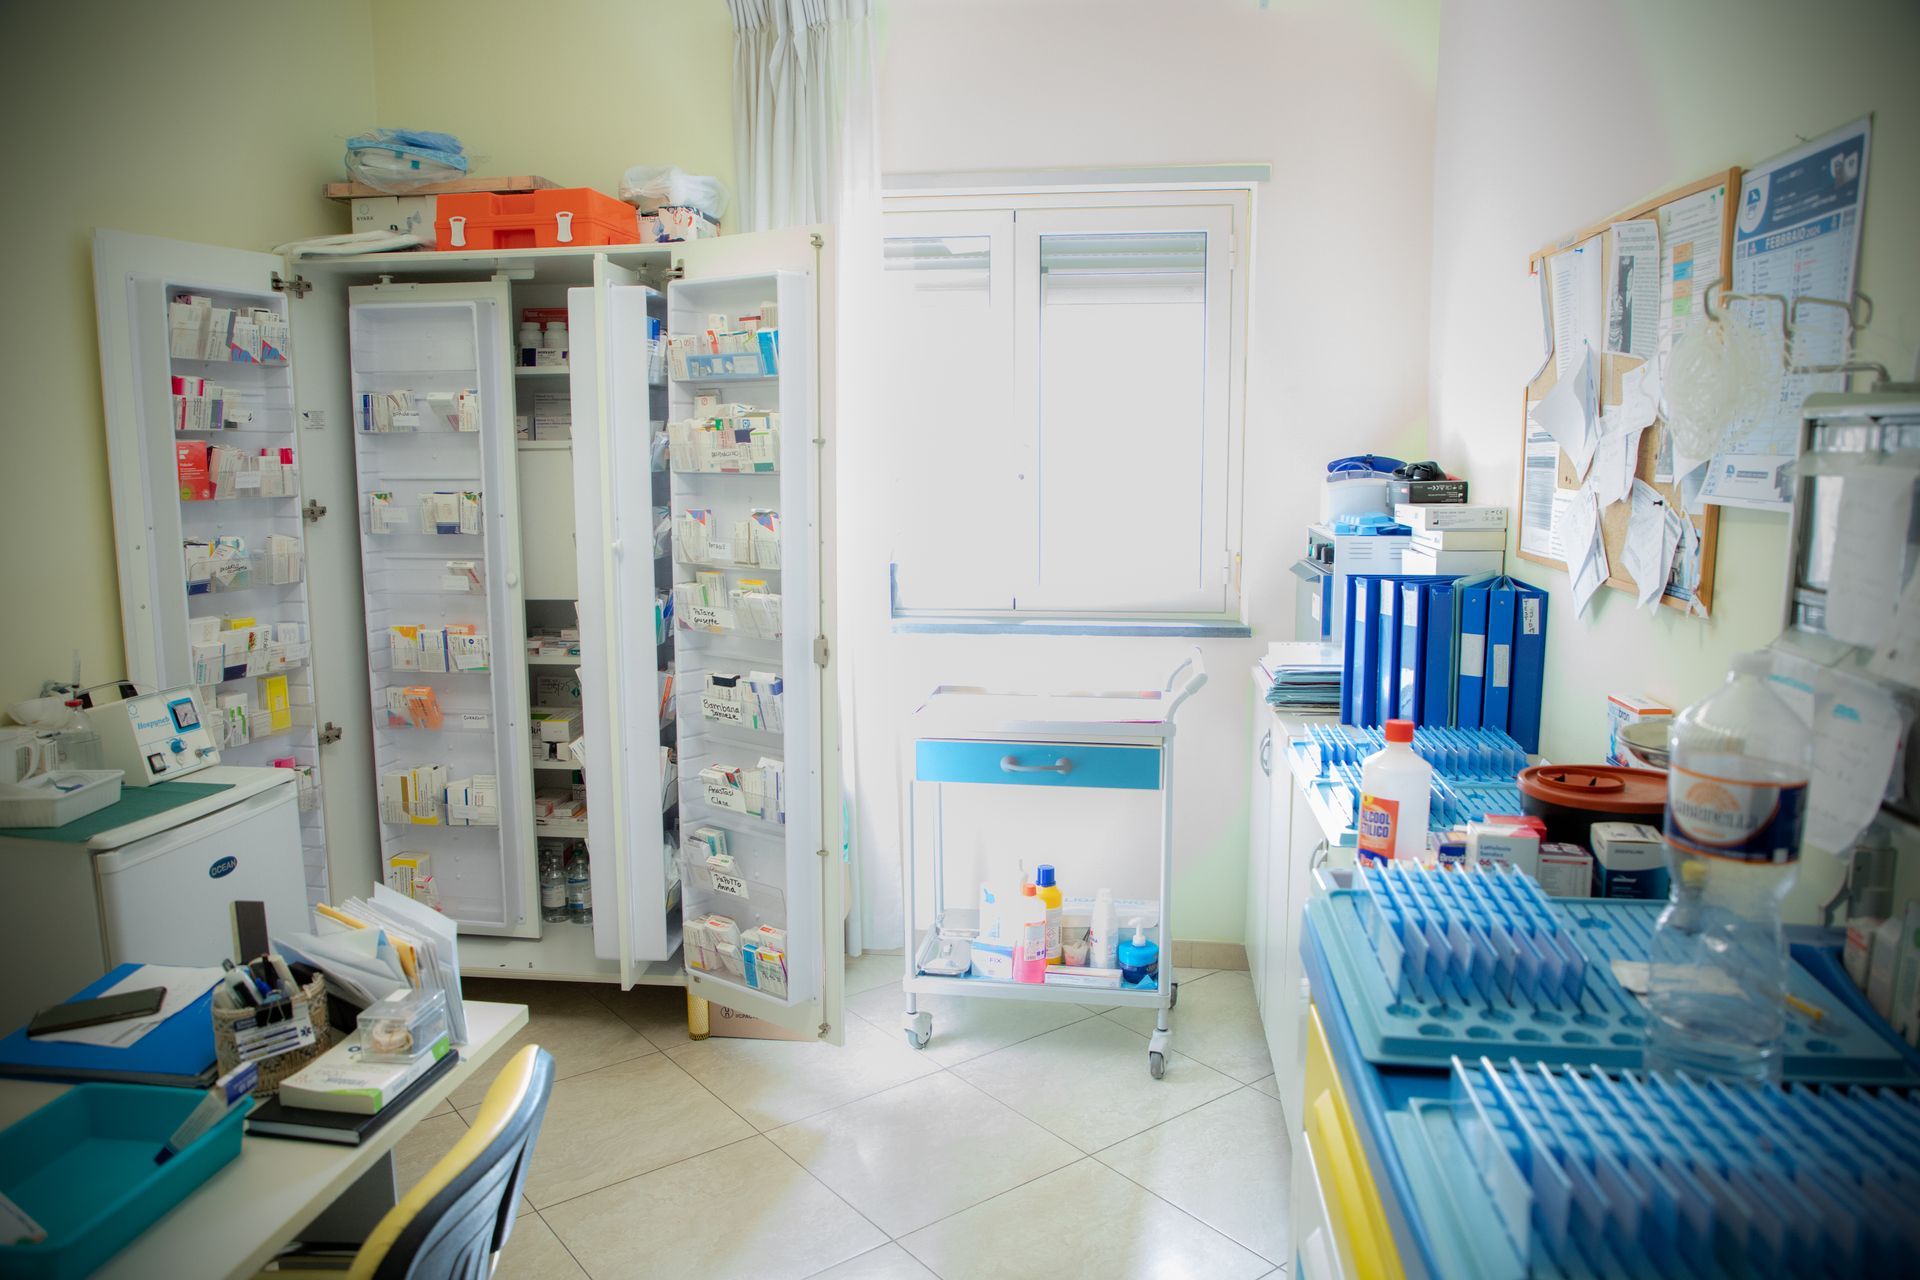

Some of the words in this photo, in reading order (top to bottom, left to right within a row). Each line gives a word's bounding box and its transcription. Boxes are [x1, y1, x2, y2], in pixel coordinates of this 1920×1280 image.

[1765, 227, 1806, 251] FEBBRAIO
[1362, 810, 1390, 825] ALCOOL
[1361, 822, 1389, 838] ETILICO
[211, 859, 237, 876] OCEAN
